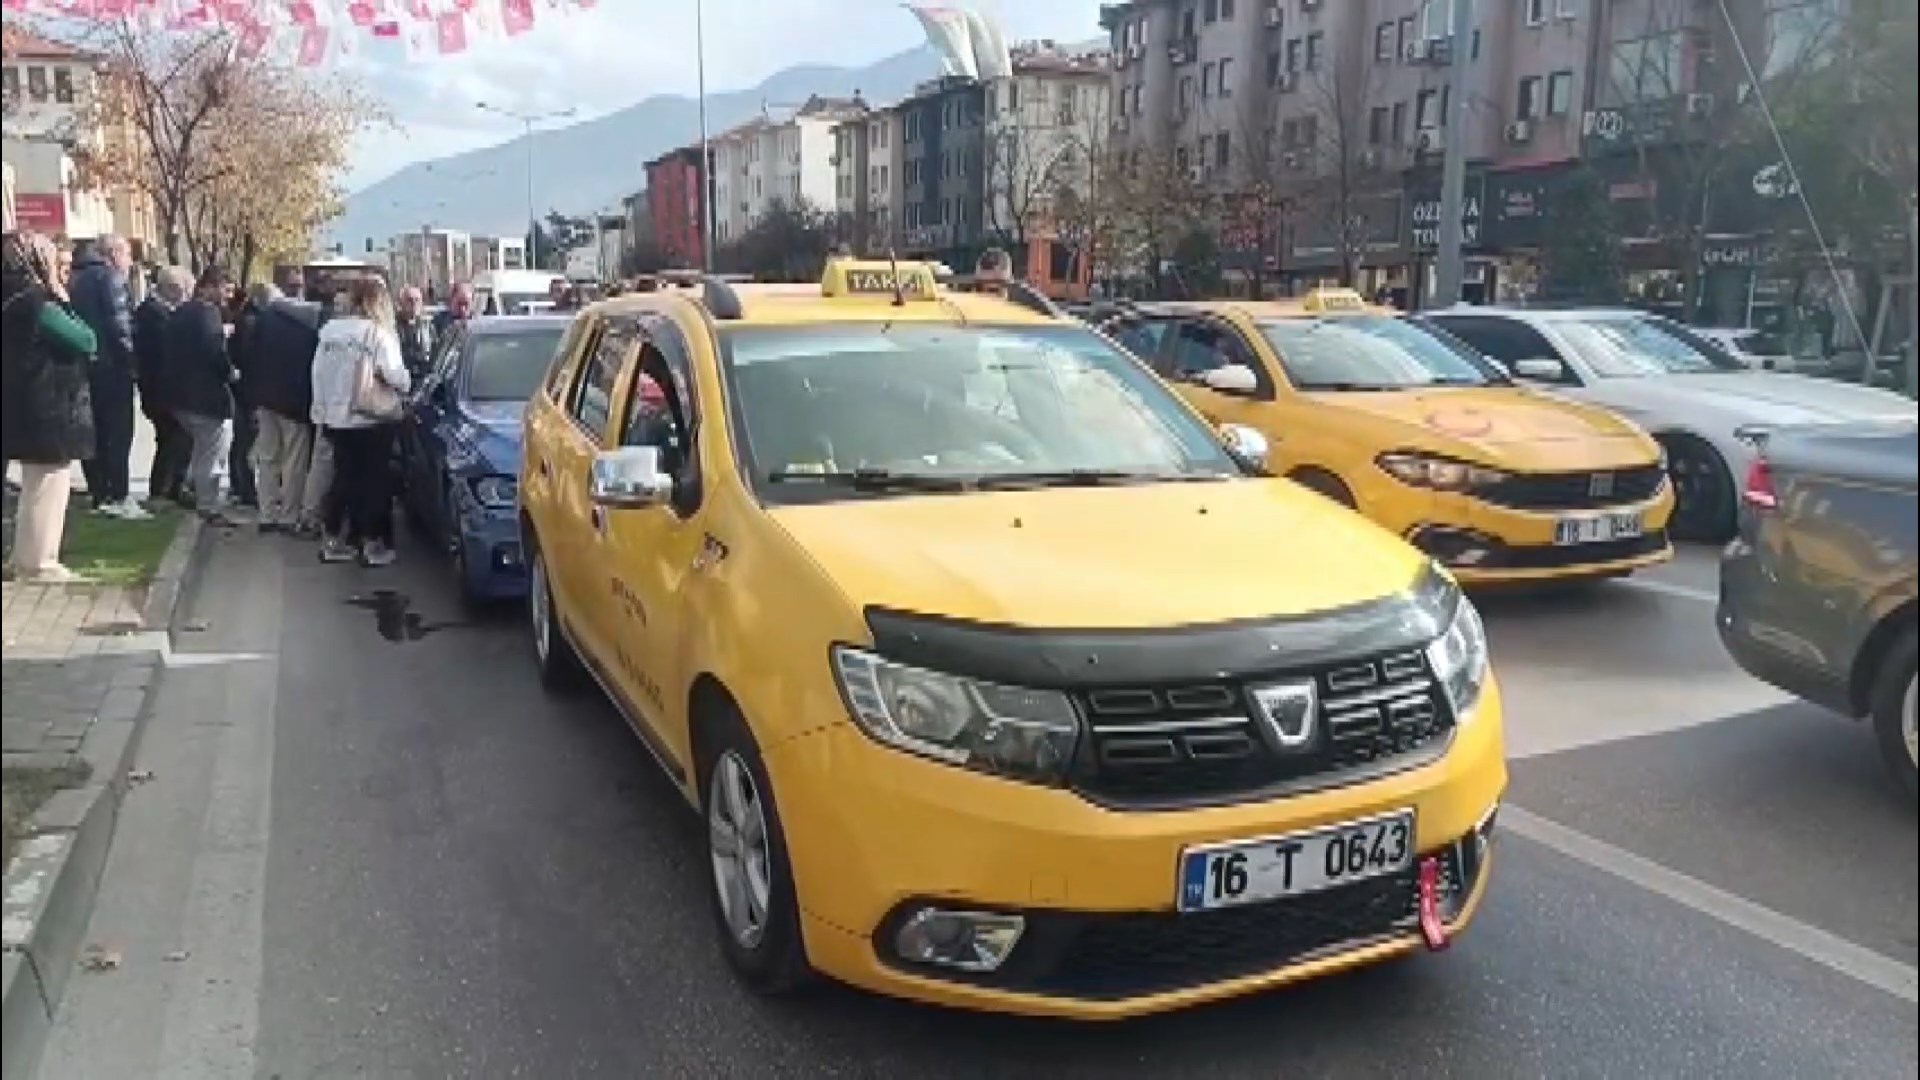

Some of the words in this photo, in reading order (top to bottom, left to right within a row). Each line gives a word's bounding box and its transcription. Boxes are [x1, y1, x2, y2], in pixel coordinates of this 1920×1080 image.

[1211, 852, 1248, 899] 16
[1276, 842, 1303, 890] T
[1324, 824, 1408, 877] 0643
